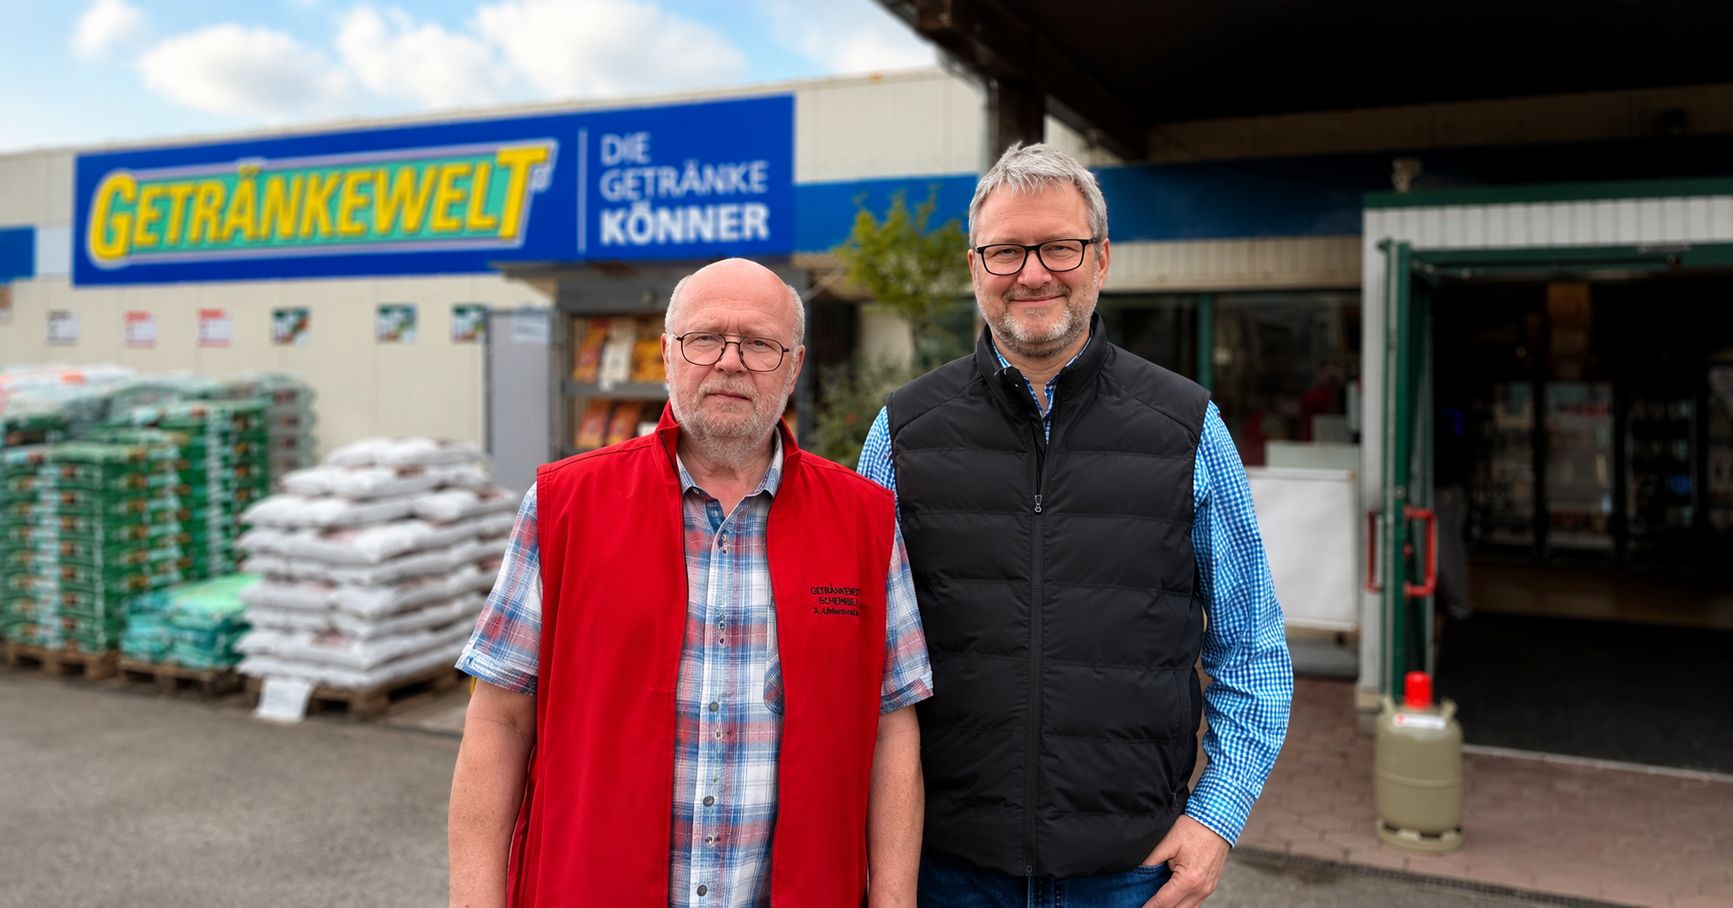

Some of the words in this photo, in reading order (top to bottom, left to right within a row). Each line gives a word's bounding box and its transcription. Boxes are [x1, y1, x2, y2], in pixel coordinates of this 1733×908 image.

[601, 132, 650, 166] DIE
[600, 160, 768, 201] GETRÄNKE
[91, 145, 549, 261] GETRÄNKEWELT
[601, 201, 770, 245] KÖNNER
